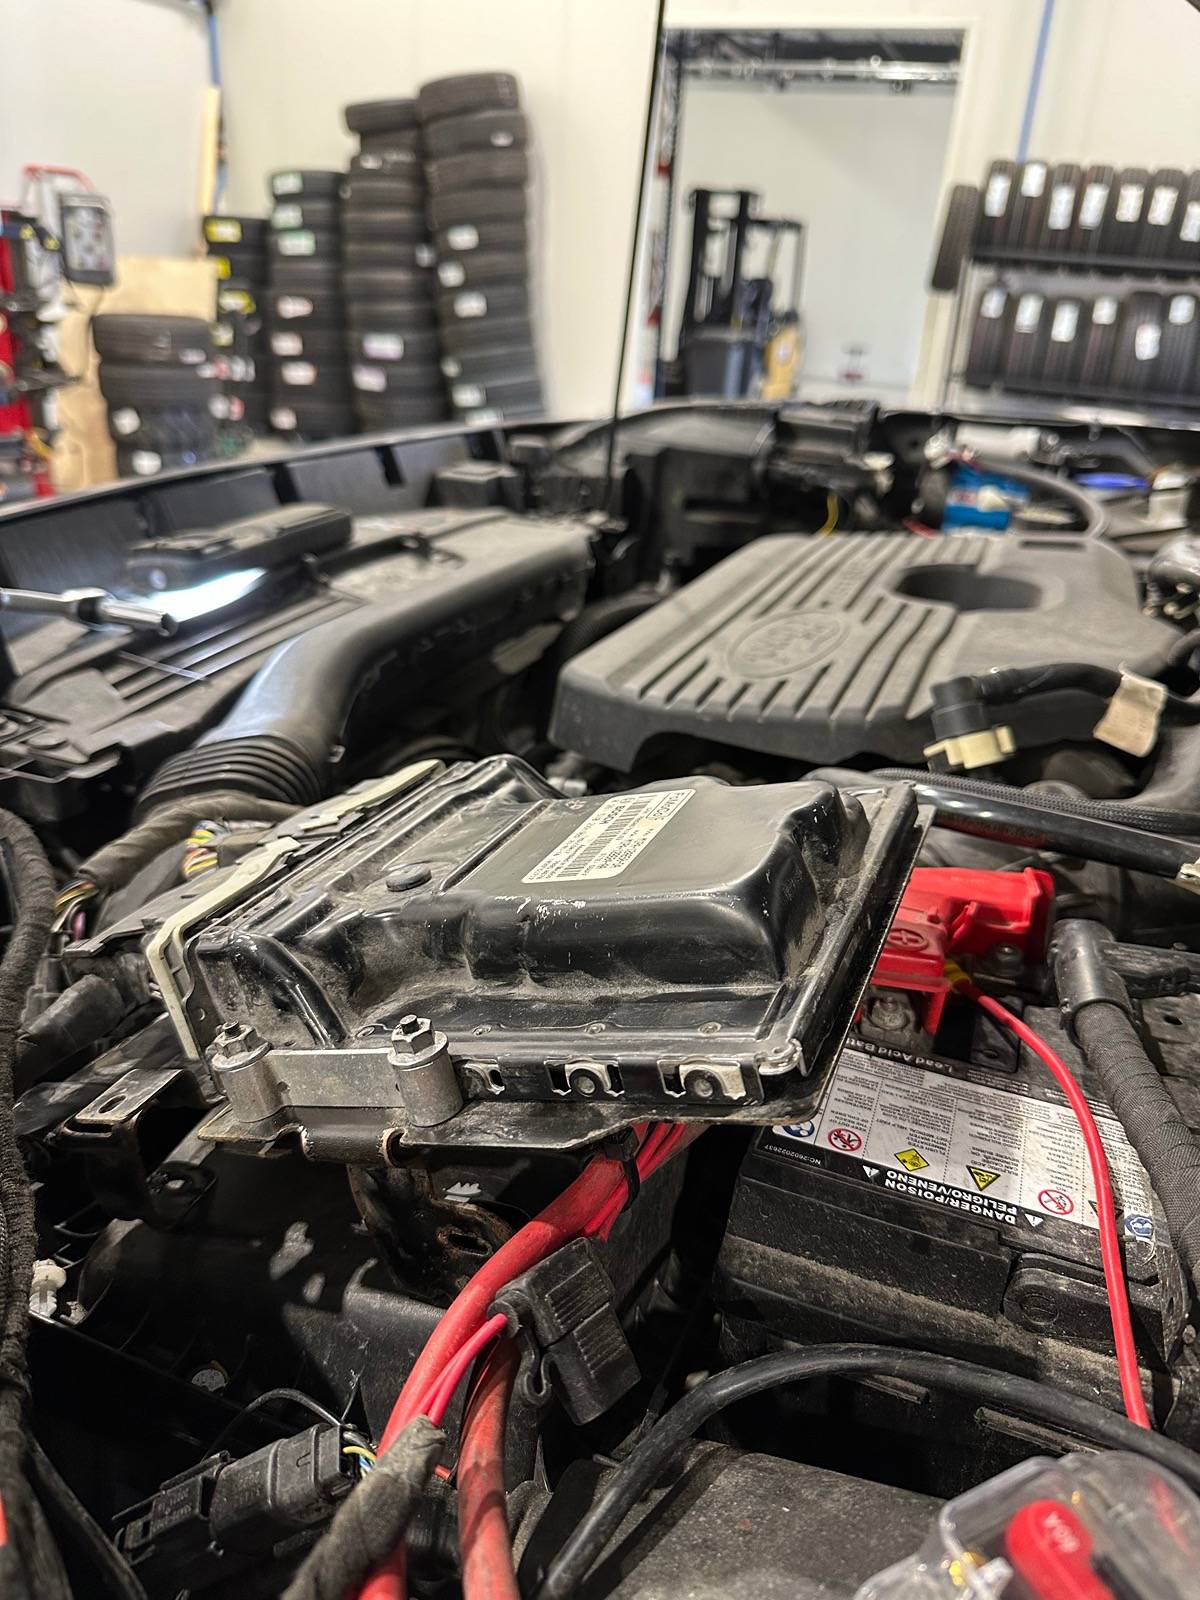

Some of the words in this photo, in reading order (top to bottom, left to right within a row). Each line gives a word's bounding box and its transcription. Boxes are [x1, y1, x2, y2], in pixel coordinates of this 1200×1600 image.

[600, 805, 626, 825] BOSCH
[846, 1037, 875, 1052] Batt
[878, 1047, 913, 1061] Acid
[915, 1057, 953, 1073] Lead
[886, 1170, 1018, 1215] PELIGRO/VENENO
[885, 1179, 1016, 1225] DANGER/POISON
